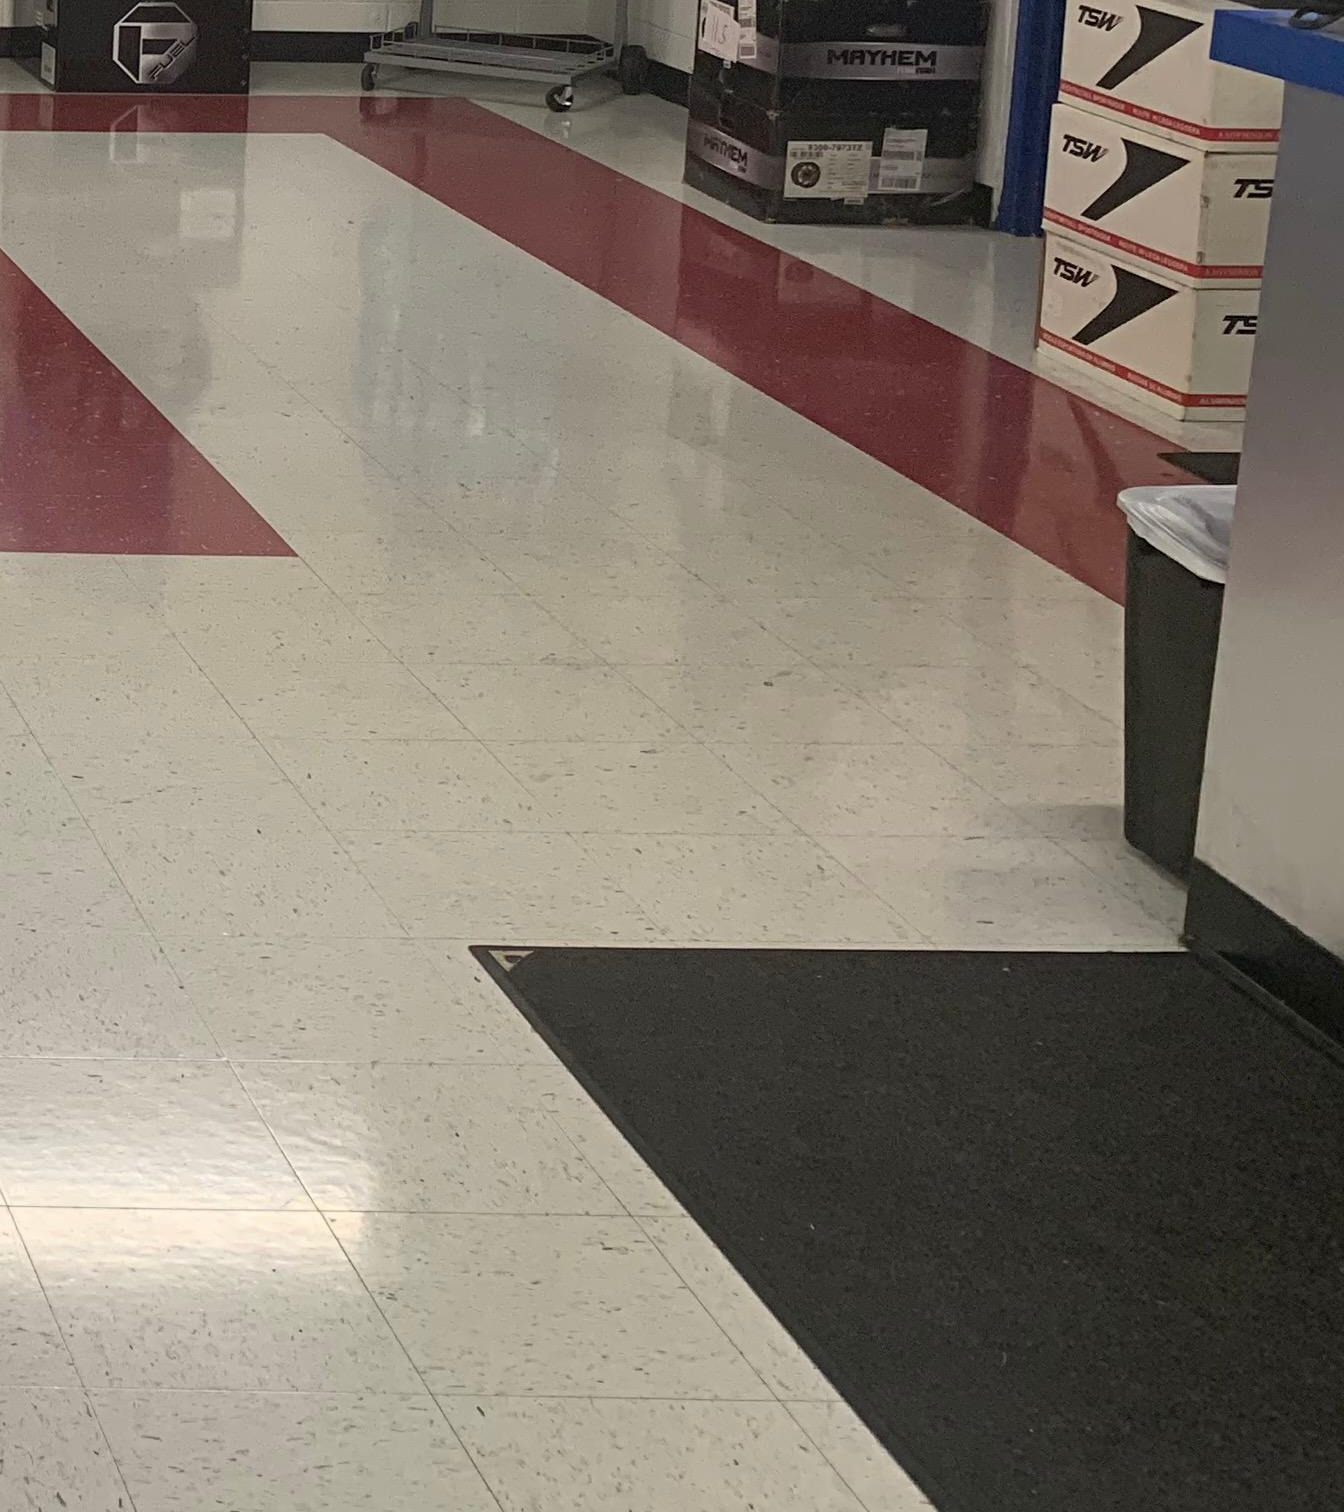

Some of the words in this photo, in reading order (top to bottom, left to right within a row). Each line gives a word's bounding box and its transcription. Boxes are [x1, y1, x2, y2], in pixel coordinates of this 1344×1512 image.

[1078, 5, 1124, 31] TSW
[149, 36, 197, 81] FUEL
[827, 49, 937, 66] MAYHEM
[1062, 134, 1109, 163] TSW
[1233, 178, 1274, 199] TS
[1054, 257, 1100, 288] TSW
[1222, 315, 1258, 335] TS
